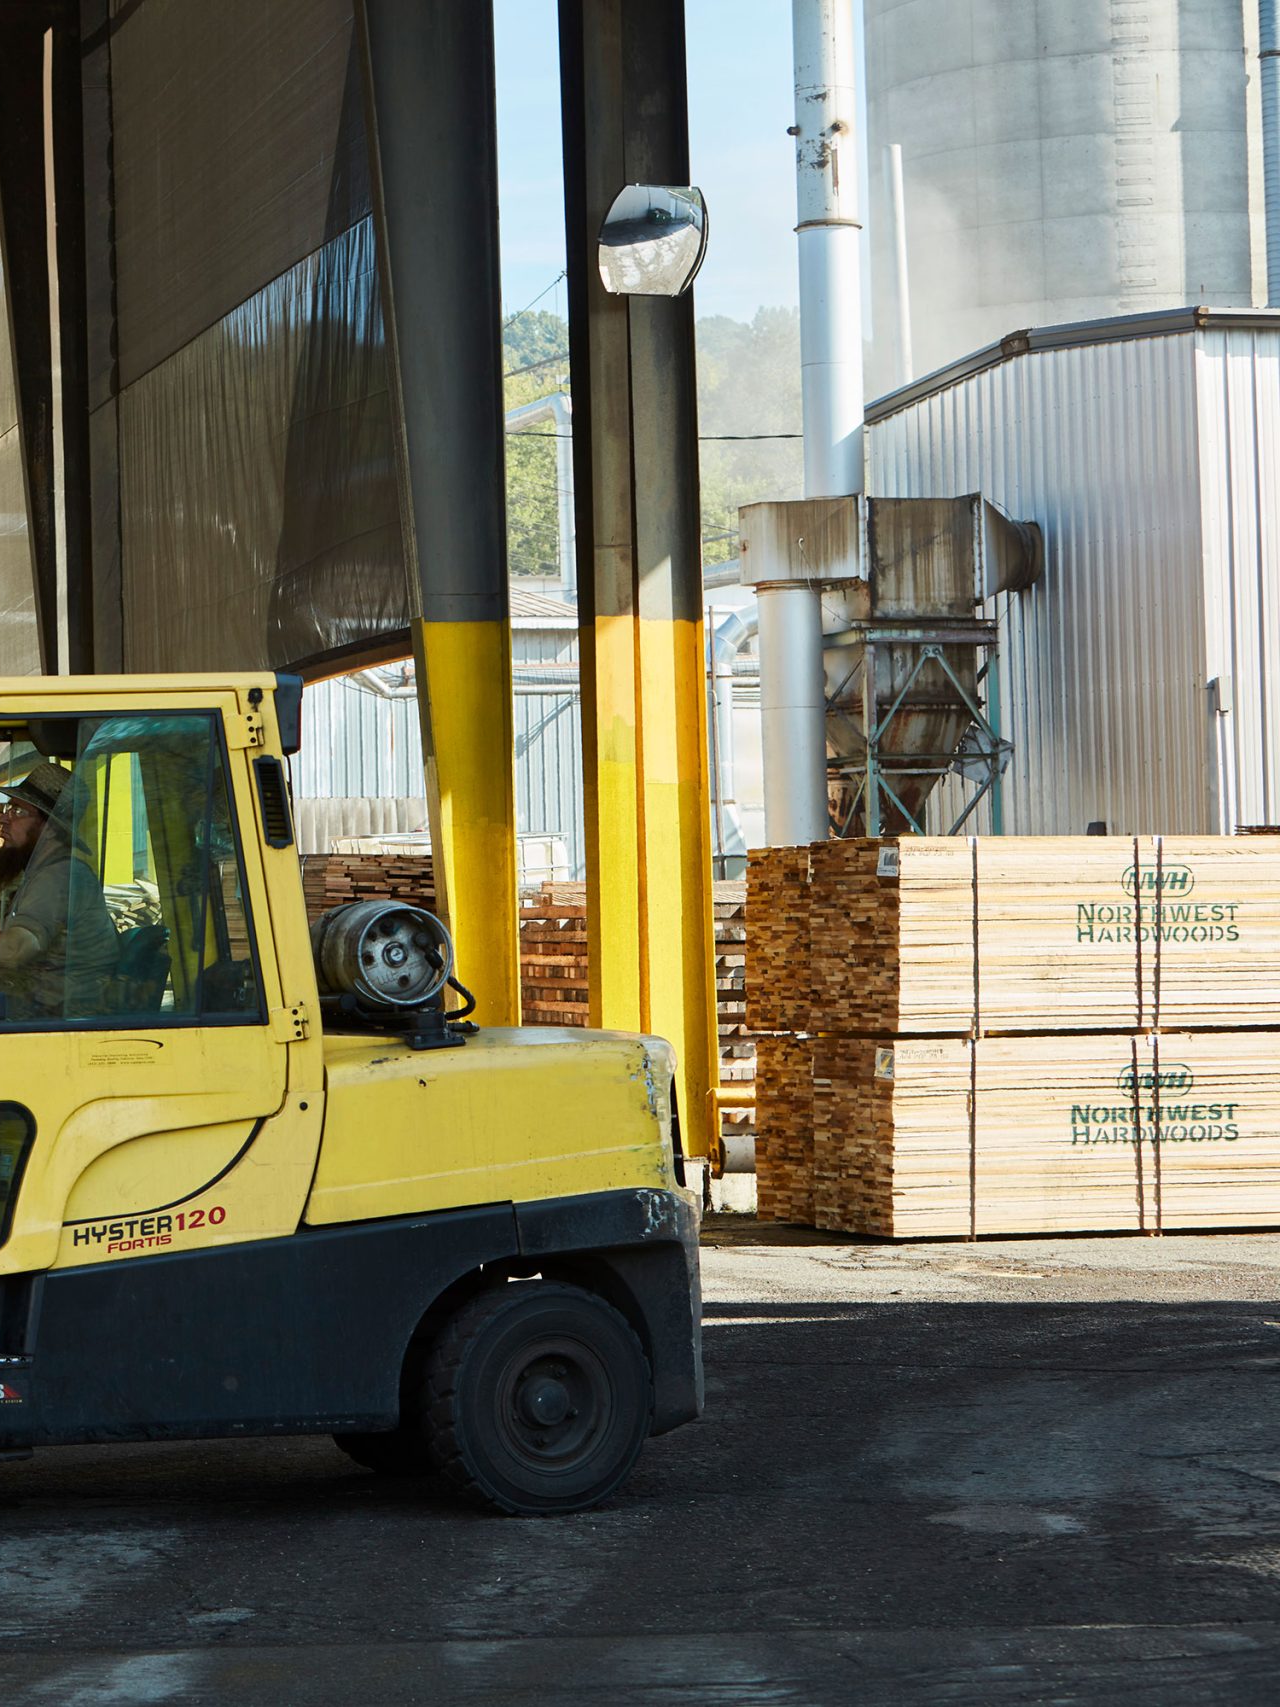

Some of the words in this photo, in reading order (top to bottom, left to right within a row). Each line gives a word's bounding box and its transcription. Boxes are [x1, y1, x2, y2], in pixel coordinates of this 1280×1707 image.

[1127, 871, 1188, 890] NWH
[1077, 903, 1239, 924] NORTHWEST
[1077, 924, 1239, 943] HARDWOODS
[1122, 1072, 1188, 1089] NWH
[1071, 1103, 1239, 1124] NORTHWEST
[1072, 1123, 1239, 1145] HARDWOODS
[73, 1215, 172, 1246] HYSTER
[175, 1206, 226, 1231] 120
[107, 1234, 172, 1253] FORTIS
